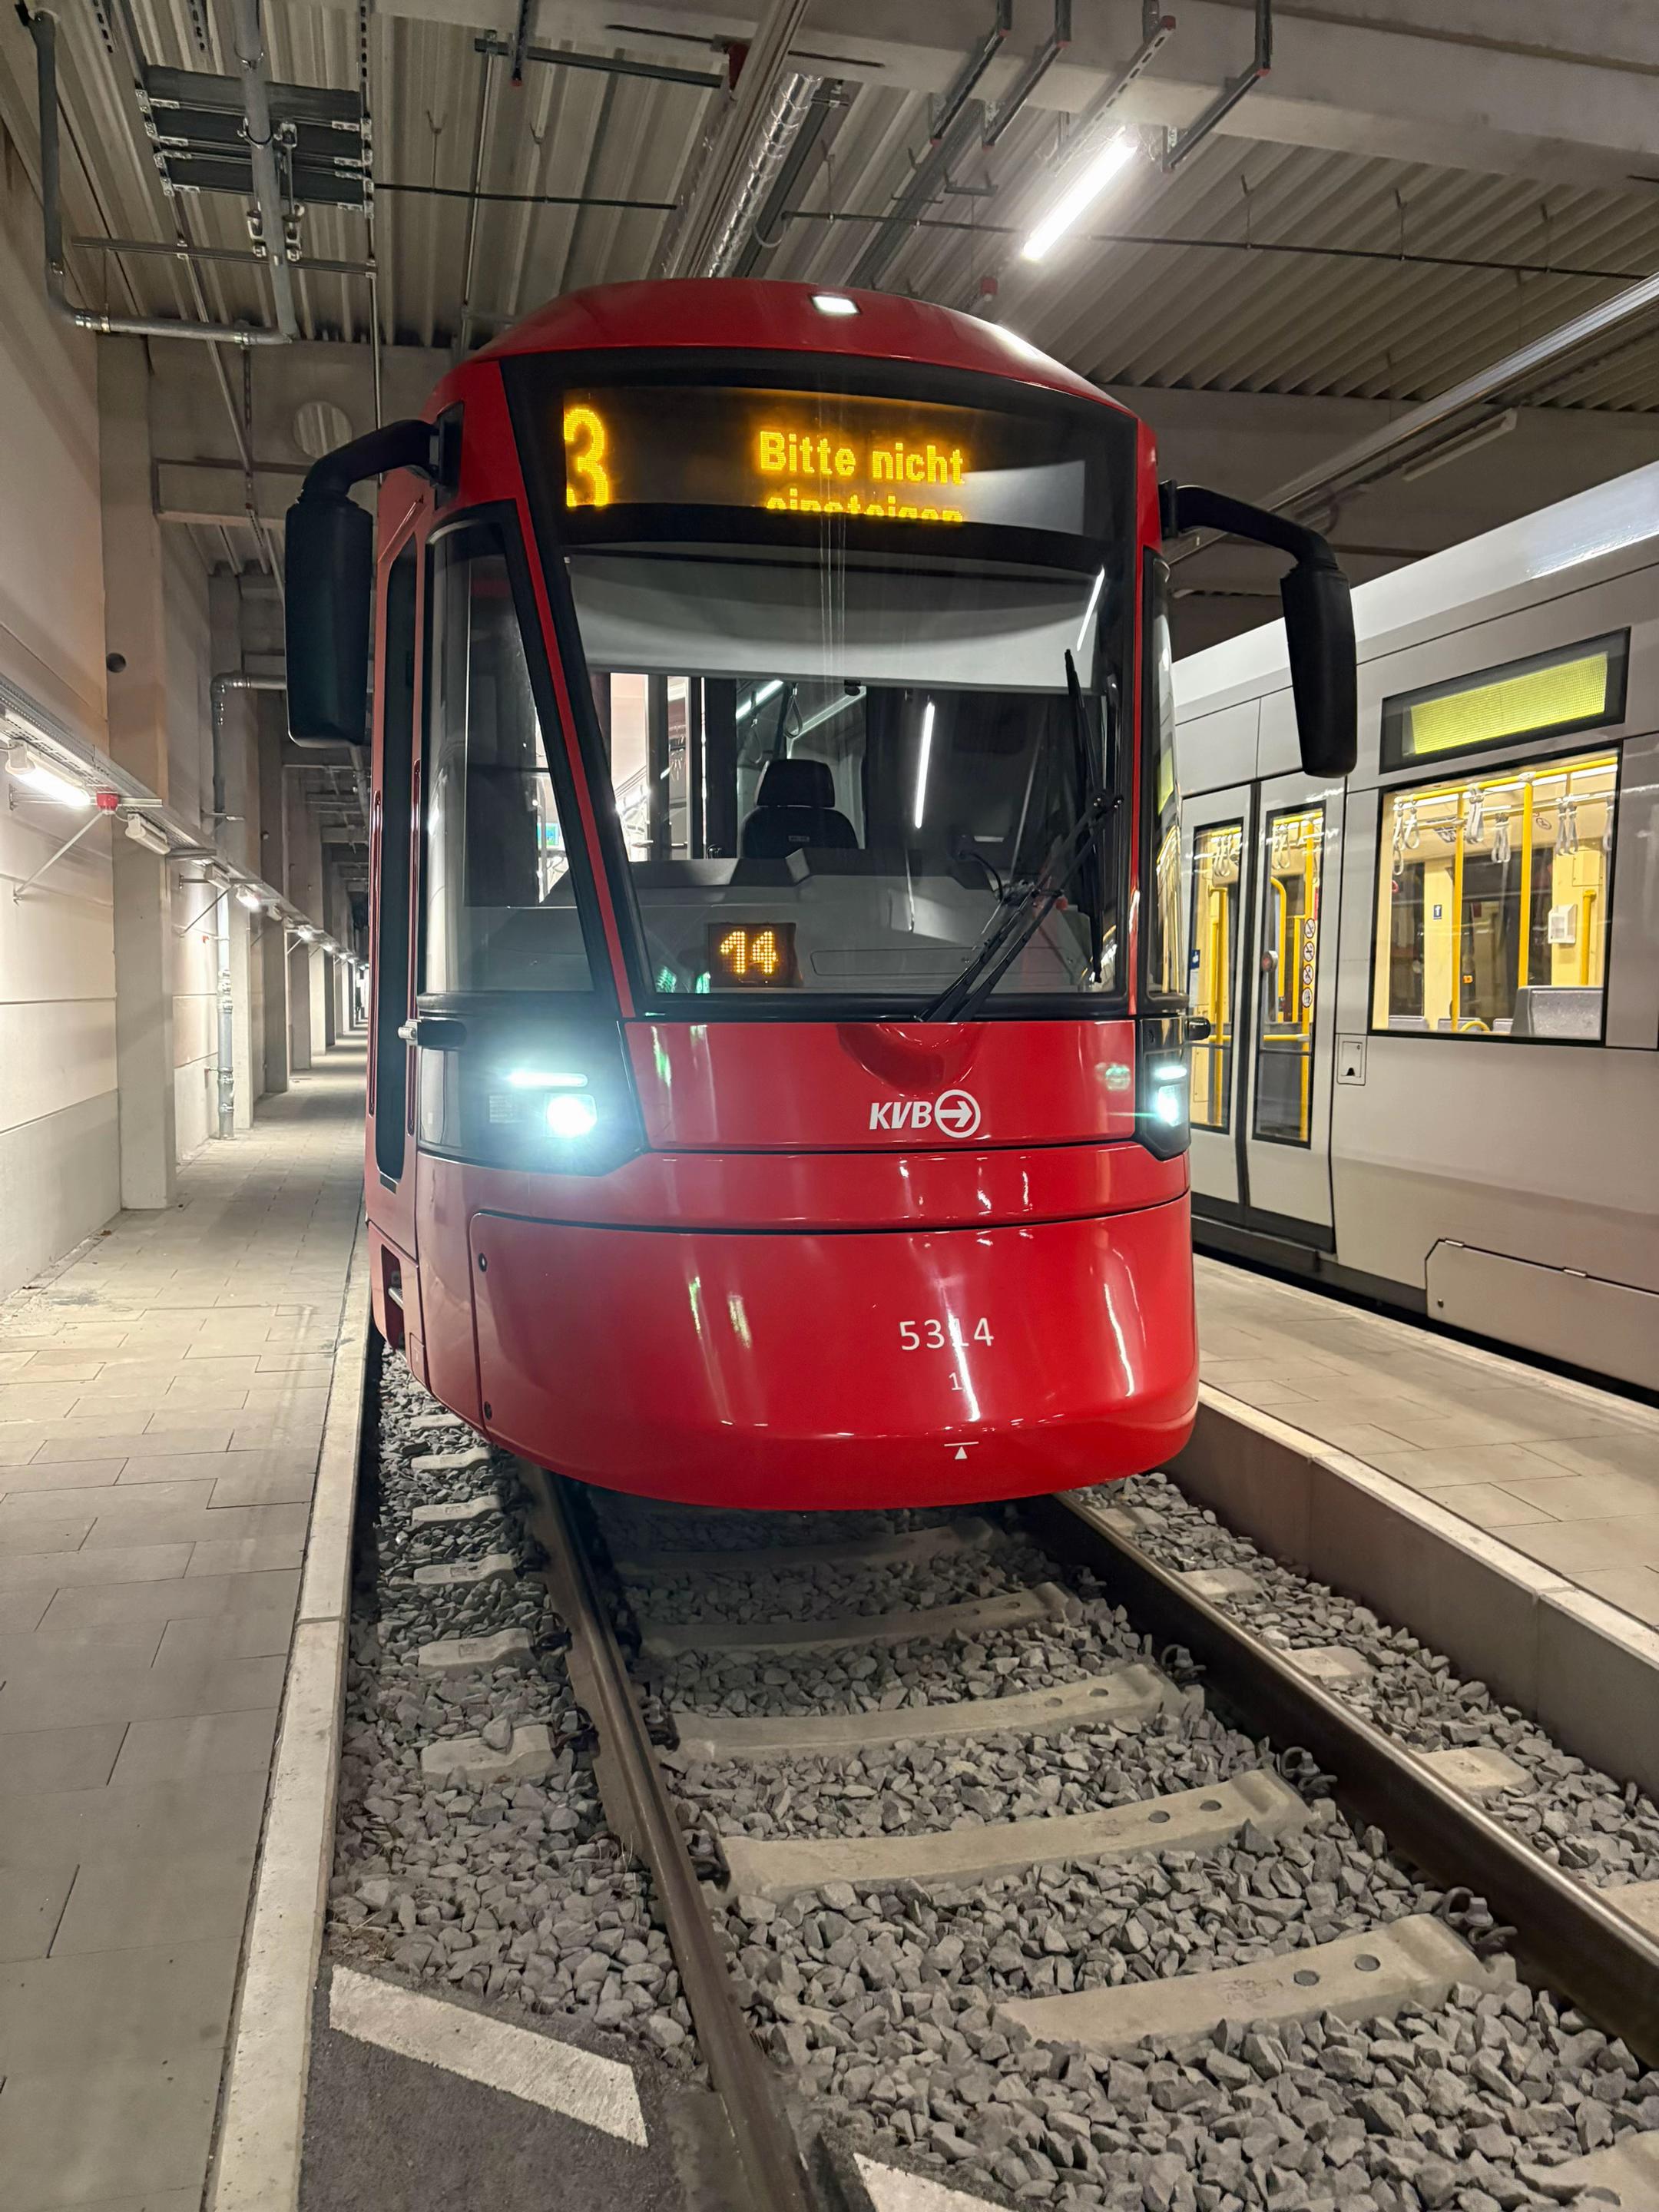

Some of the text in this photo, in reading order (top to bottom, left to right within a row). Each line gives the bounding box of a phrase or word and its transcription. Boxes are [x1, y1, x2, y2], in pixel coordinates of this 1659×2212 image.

[563, 409, 609, 507] 3
[760, 431, 965, 485] Bitte nicht
[720, 931, 777, 974] 14
[869, 1101, 932, 1131] KVB
